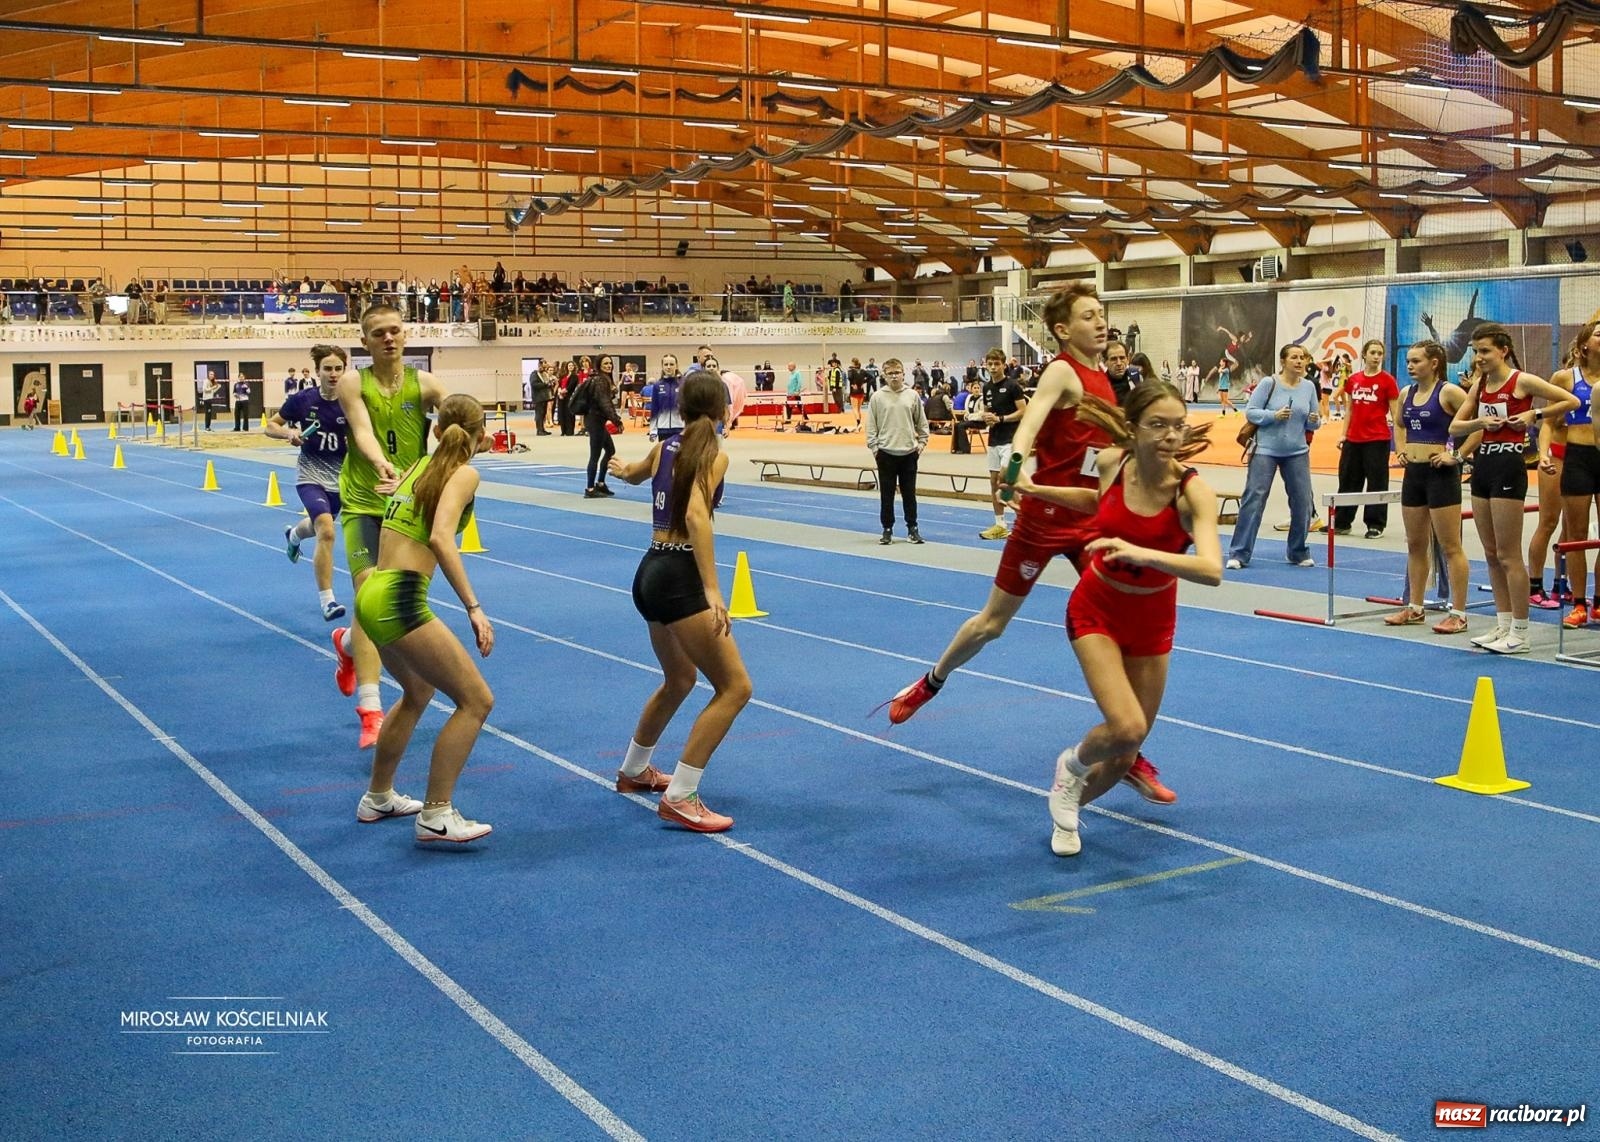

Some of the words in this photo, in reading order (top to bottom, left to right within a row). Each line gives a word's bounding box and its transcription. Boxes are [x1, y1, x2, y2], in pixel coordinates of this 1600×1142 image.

[1484, 405, 1499, 417] 39
[317, 431, 339, 452] 70
[386, 430, 398, 455] 9
[655, 491, 666, 510] 49
